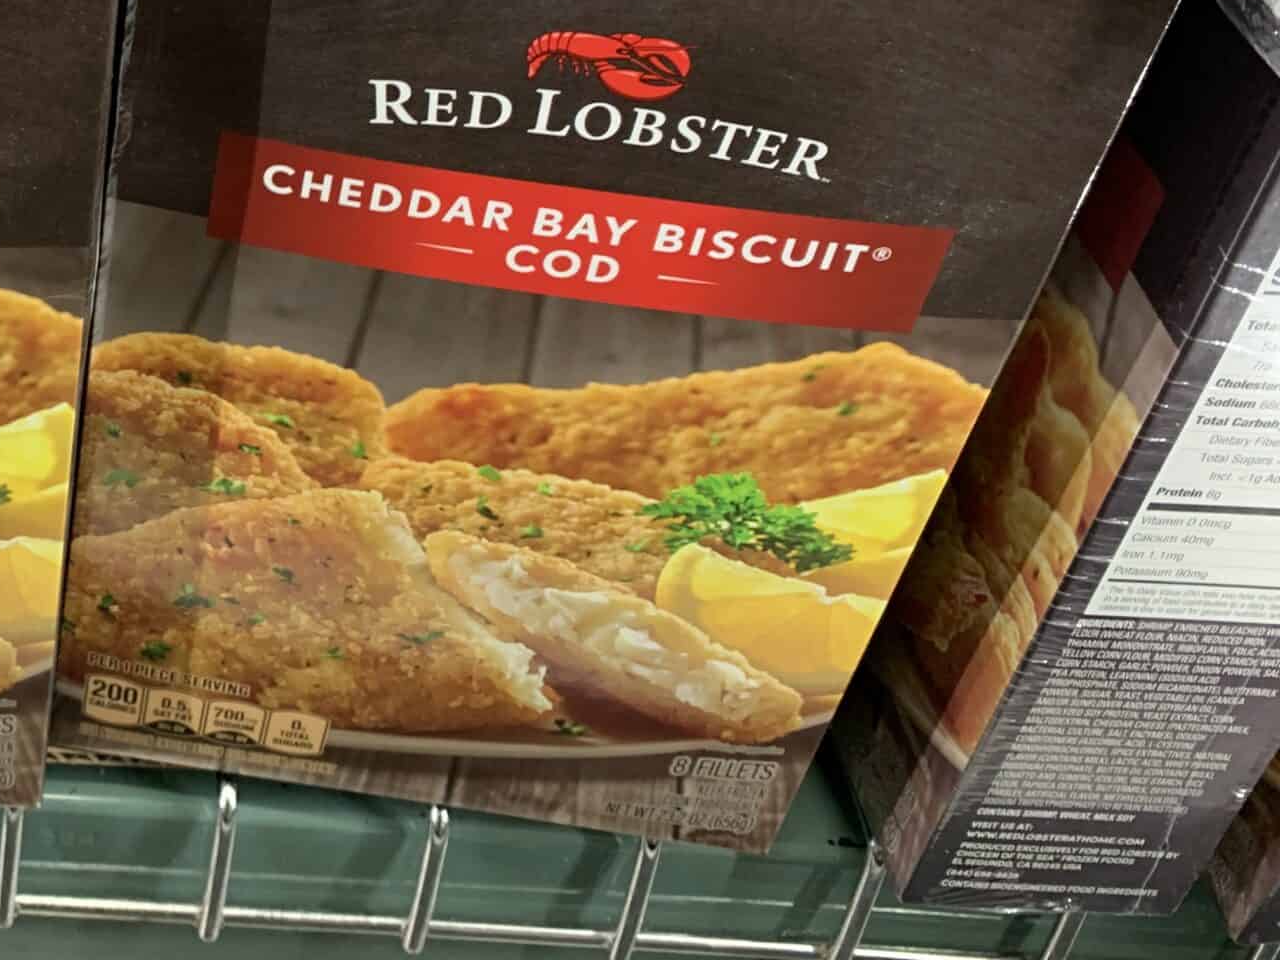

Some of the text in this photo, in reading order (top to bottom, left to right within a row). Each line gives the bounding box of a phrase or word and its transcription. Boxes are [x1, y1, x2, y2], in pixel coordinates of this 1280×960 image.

[368, 78, 831, 182] RED LOBSTER
[262, 163, 513, 231] CHEDDAR
[531, 207, 637, 246] BAY
[505, 244, 620, 284] COD
[1204, 396, 1256, 409] Sodium
[1196, 416, 1230, 426] Total
[1156, 487, 1203, 498] Protein
[1141, 516, 1184, 528] Vitamin
[1121, 550, 1145, 560] Iron
[92, 679, 138, 704] 200
[671, 758, 777, 779] 8 FILLETS
[971, 821, 998, 830] VISIT
[1000, 822, 1016, 830] US
